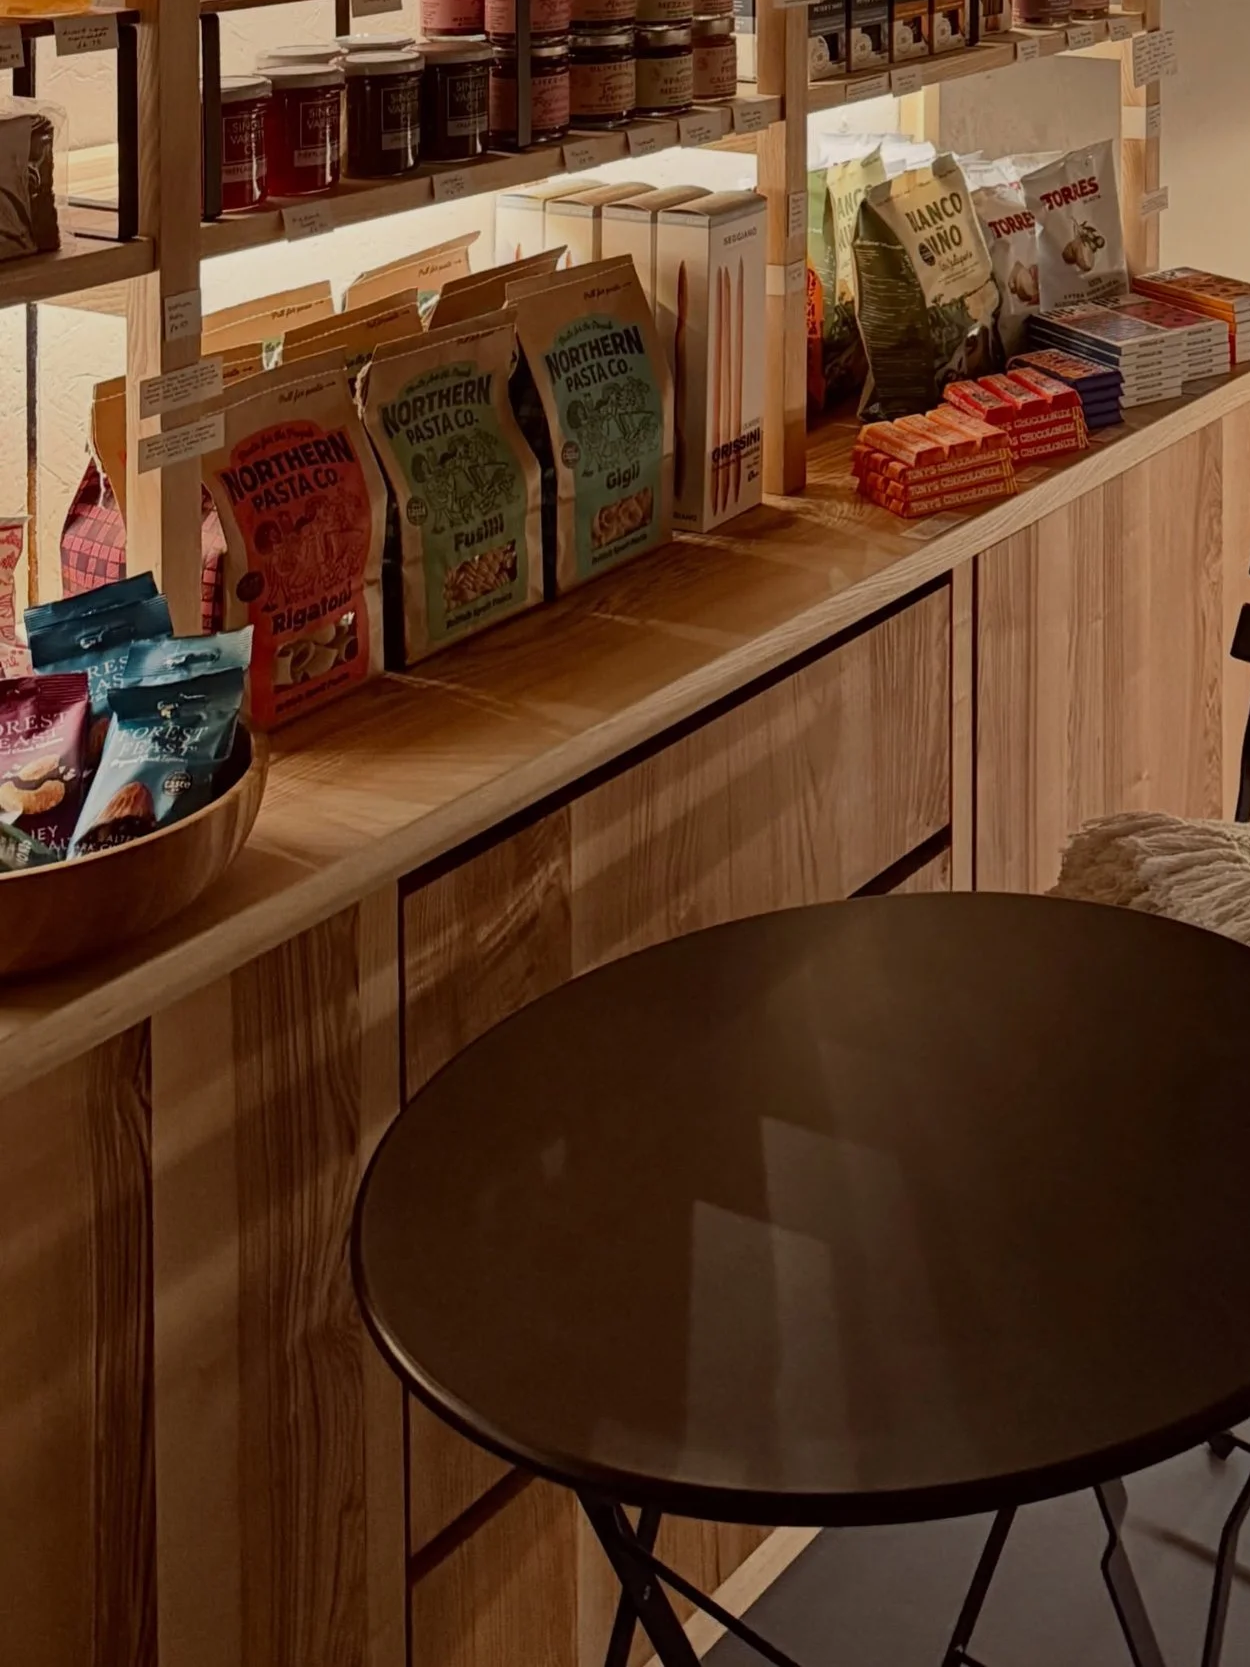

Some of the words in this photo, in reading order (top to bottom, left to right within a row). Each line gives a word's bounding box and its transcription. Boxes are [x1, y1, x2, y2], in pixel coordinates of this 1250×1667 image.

[1040, 176, 1099, 211] TORRES
[544, 325, 646, 387] NORTHERN
[565, 361, 609, 393] PASTA
[380, 373, 493, 440] NORTHERN
[405, 413, 456, 447] PASTA
[711, 426, 760, 464] GRISSINI
[219, 430, 355, 507] NORTHERN
[605, 460, 641, 491] Gigli
[251, 472, 315, 514] PASTA
[453, 511, 505, 552] Fusilli
[271, 586, 353, 636] Rigatoni
[87, 655, 129, 678] RES
[119, 725, 209, 744] FOREST
